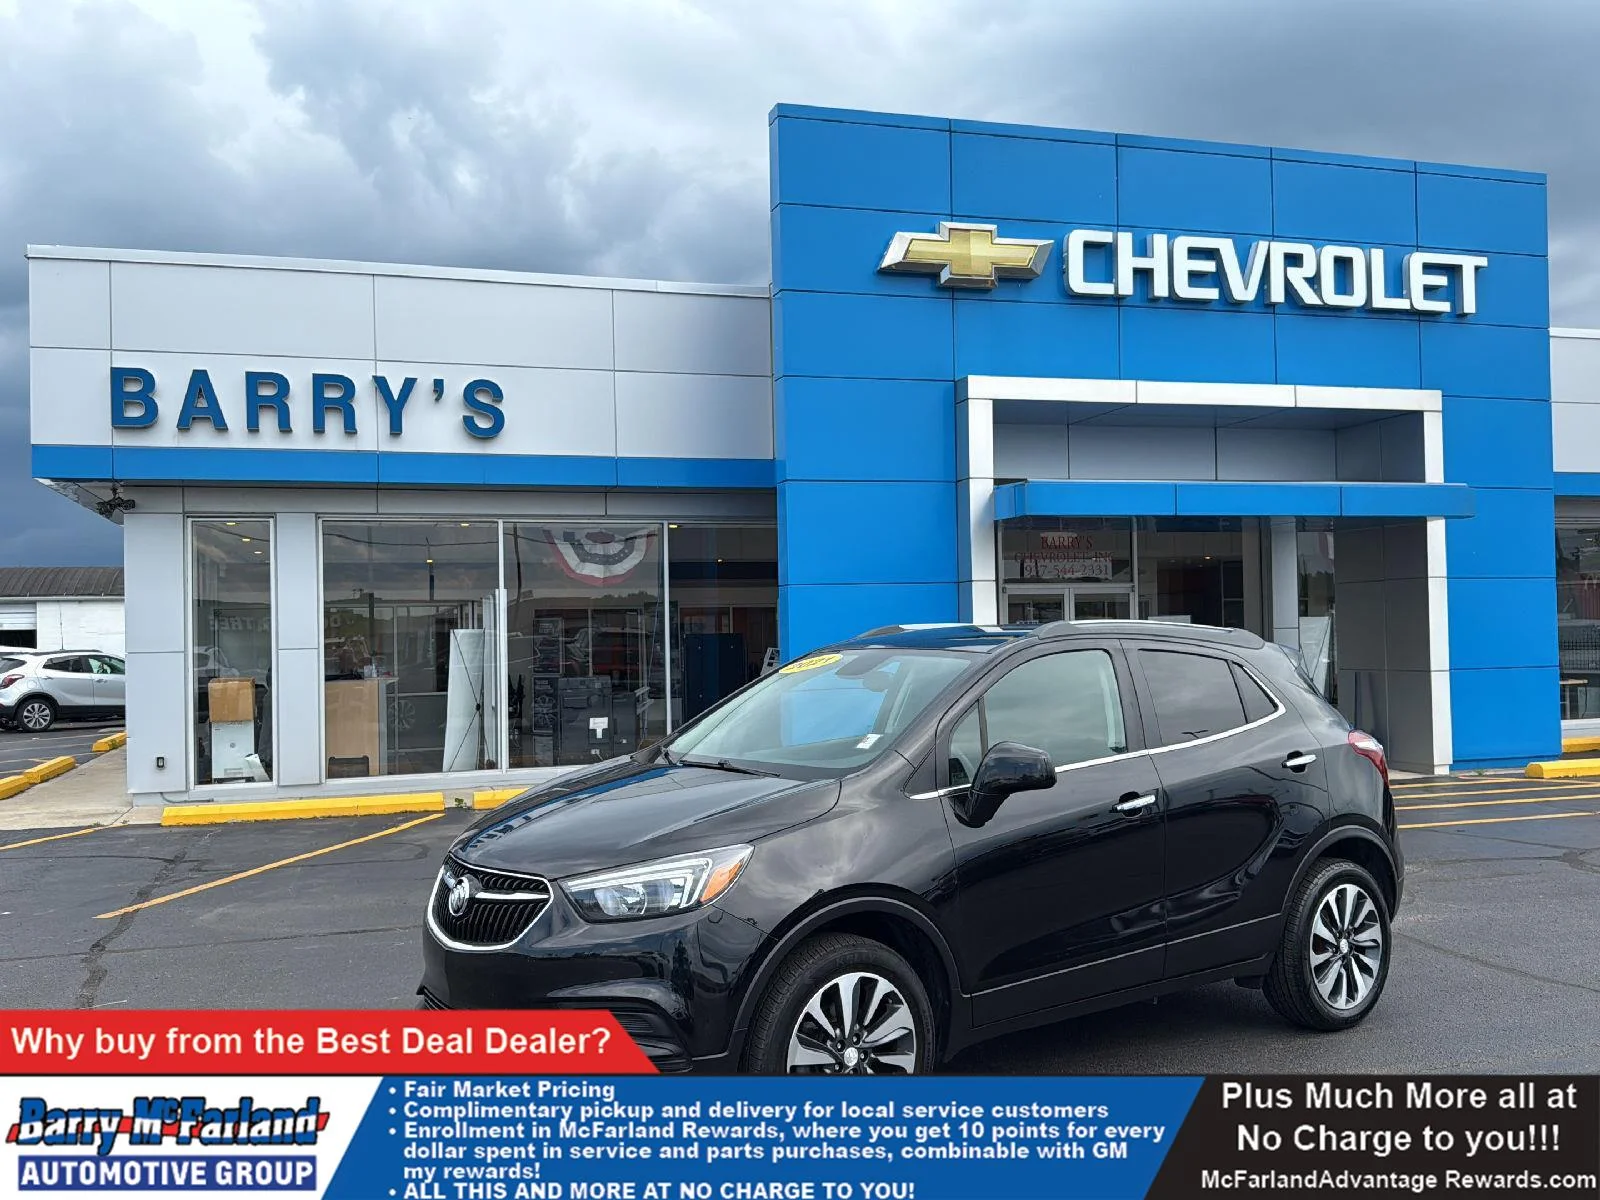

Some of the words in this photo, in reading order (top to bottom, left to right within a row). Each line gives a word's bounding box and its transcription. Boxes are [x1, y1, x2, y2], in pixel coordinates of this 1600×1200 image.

[1063, 229, 1488, 315] CHEVROLET
[111, 367, 505, 440] BARRY'S
[1041, 535, 1093, 550] BARRY'S
